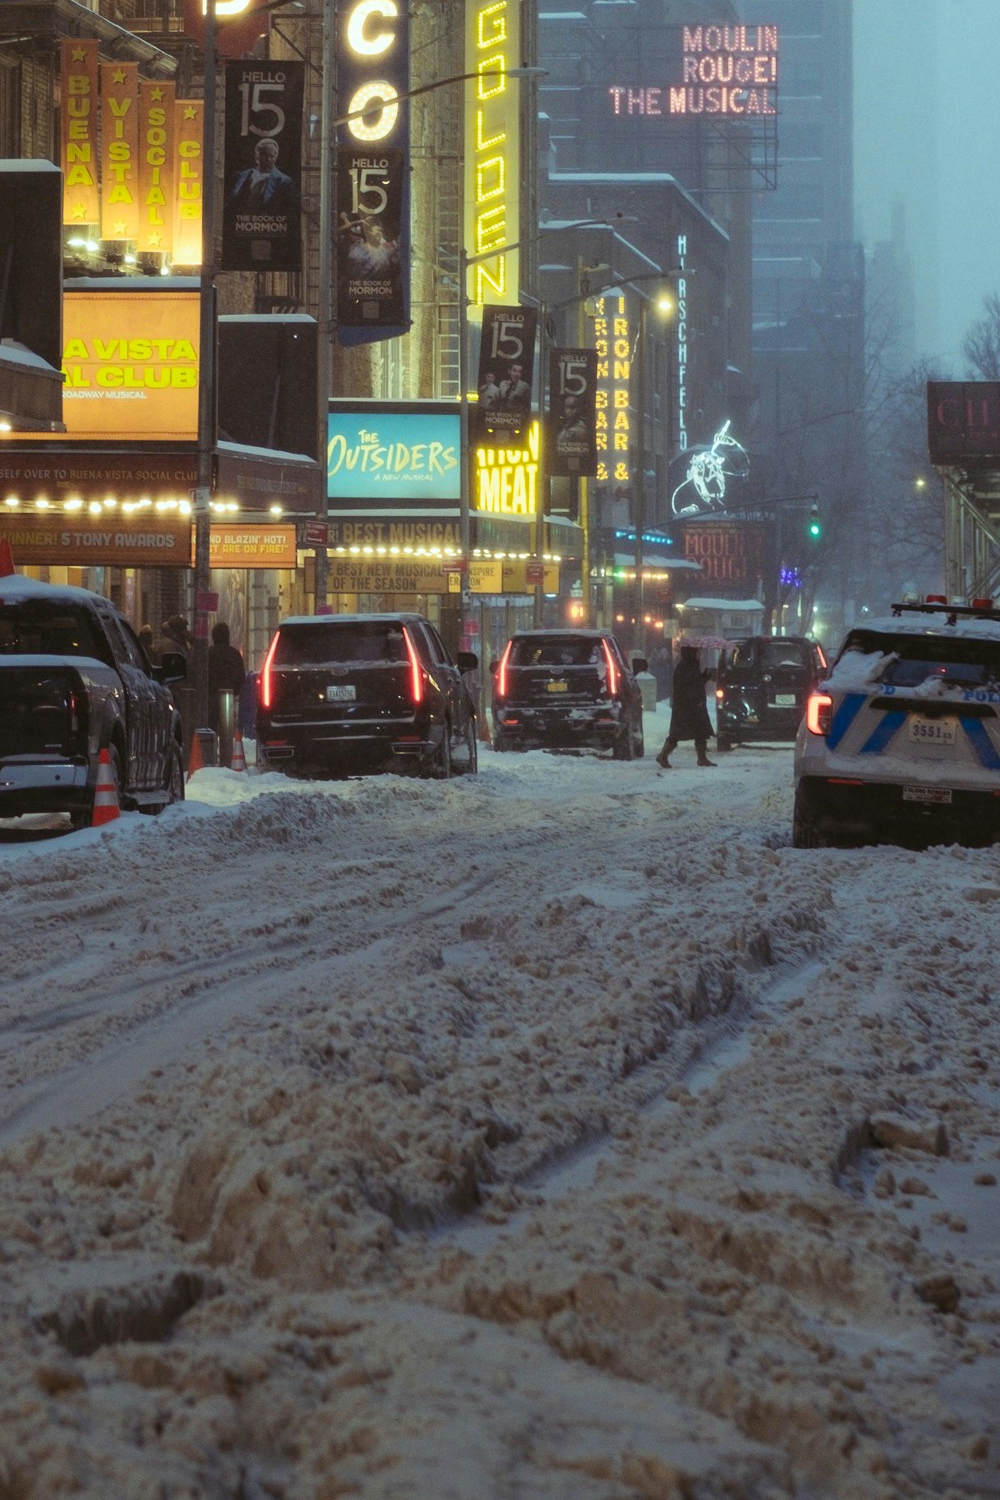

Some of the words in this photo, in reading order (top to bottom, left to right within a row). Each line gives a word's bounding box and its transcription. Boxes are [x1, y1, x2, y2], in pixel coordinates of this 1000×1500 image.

[683, 25, 778, 52] MOULIN
[242, 71, 286, 83] HELLO
[683, 56, 778, 83] ROUGE!
[238, 82, 286, 137] 15
[608, 86, 662, 115] THE
[669, 86, 777, 115] MUSICAL
[66, 76, 94, 186] BUENA
[107, 97, 133, 204] VISTA
[475, 0, 507, 307] GOLDEN
[145, 107, 167, 225] SOCIAL
[352, 159, 389, 168] HELLO
[178, 140, 201, 220] CLUB
[348, 169, 389, 214] 15
[235, 222, 288, 232] MORMON
[349, 286, 392, 295] MORMON
[494, 313, 525, 323] HELLO
[490, 322, 524, 360] 15
[613, 296, 630, 380] IRON
[677, 235, 688, 451] HIRSCHFELD
[92, 339, 198, 360] VISTA
[560, 355, 588, 363] HELLO
[96, 366, 198, 389] CLUB
[558, 362, 588, 396] 15
[105, 391, 148, 399] MUSICAL
[613, 390, 630, 451] BAR
[358, 429, 380, 444] THE
[327, 434, 458, 478] OUTSIDERS
[24, 469, 51, 479] OVER
[53, 470, 67, 479] TO
[69, 469, 102, 480] BUENA
[105, 470, 133, 480] VISTA
[135, 470, 171, 480] SOCIAL
[614, 462, 630, 481] &
[61, 532, 70, 546] 5
[74, 532, 111, 547] TONY
[115, 532, 175, 547] AWARDS
[225, 535, 261, 544] BLAZIN'
[264, 536, 287, 544] HOT!
[343, 523, 385, 543] BEST
[222, 545, 240, 553] ARE
[244, 545, 257, 553] ON
[337, 563, 363, 577] BEST
[367, 563, 393, 577] NEW
[395, 563, 443, 577] MUSICAL
[333, 577, 347, 590] OF
[351, 577, 371, 590] THE
[912, 724, 943, 739] 3551
